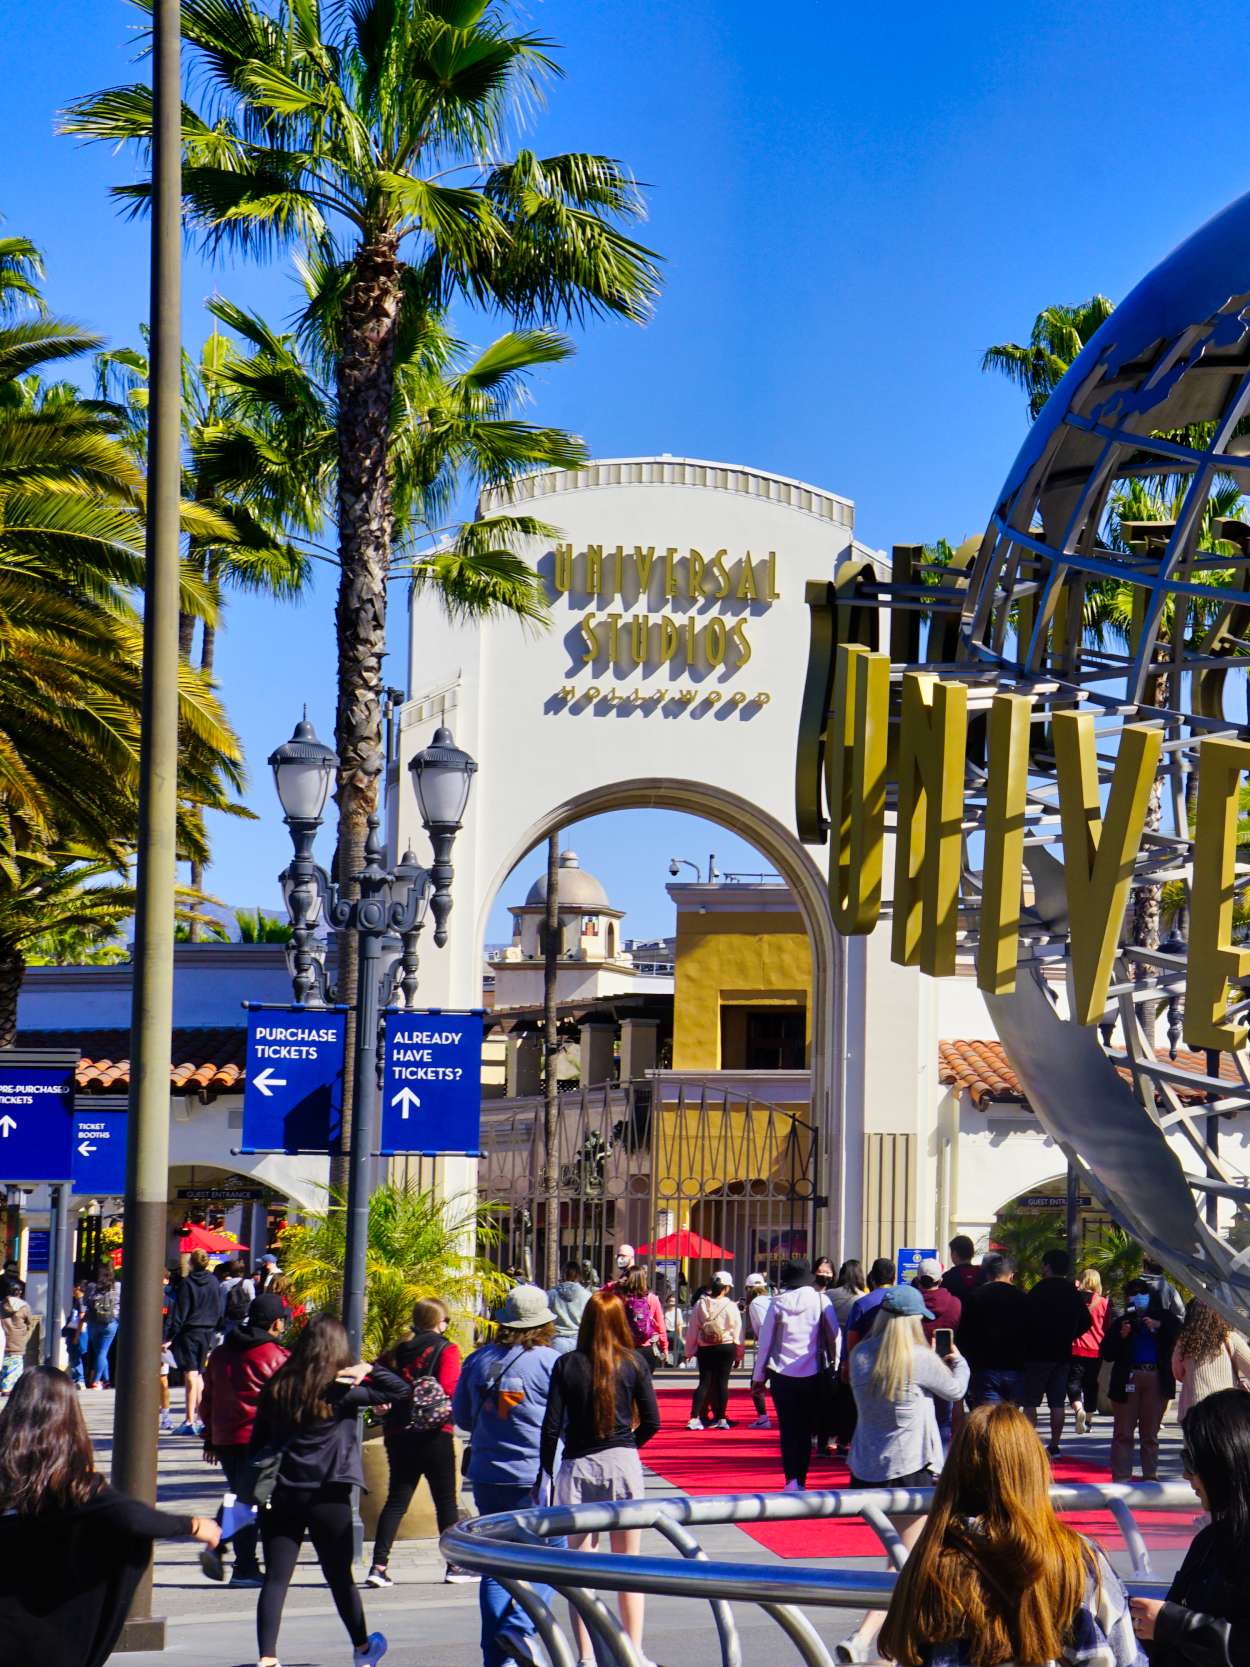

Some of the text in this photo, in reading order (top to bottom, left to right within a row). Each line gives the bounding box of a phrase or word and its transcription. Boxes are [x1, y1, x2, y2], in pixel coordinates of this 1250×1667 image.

[554, 544, 780, 600] UNIVERSAL
[581, 612, 752, 667] STUDIOS
[560, 685, 771, 705] HOLLYWOOD
[255, 1027, 337, 1042] PURCHASE
[393, 1032, 463, 1045] ALREADY
[255, 1045, 318, 1060] TICKETS
[392, 1049, 432, 1063] HAVE
[392, 1067, 463, 1081] TICKETS?
[78, 1131, 110, 1139] BOOTHS
